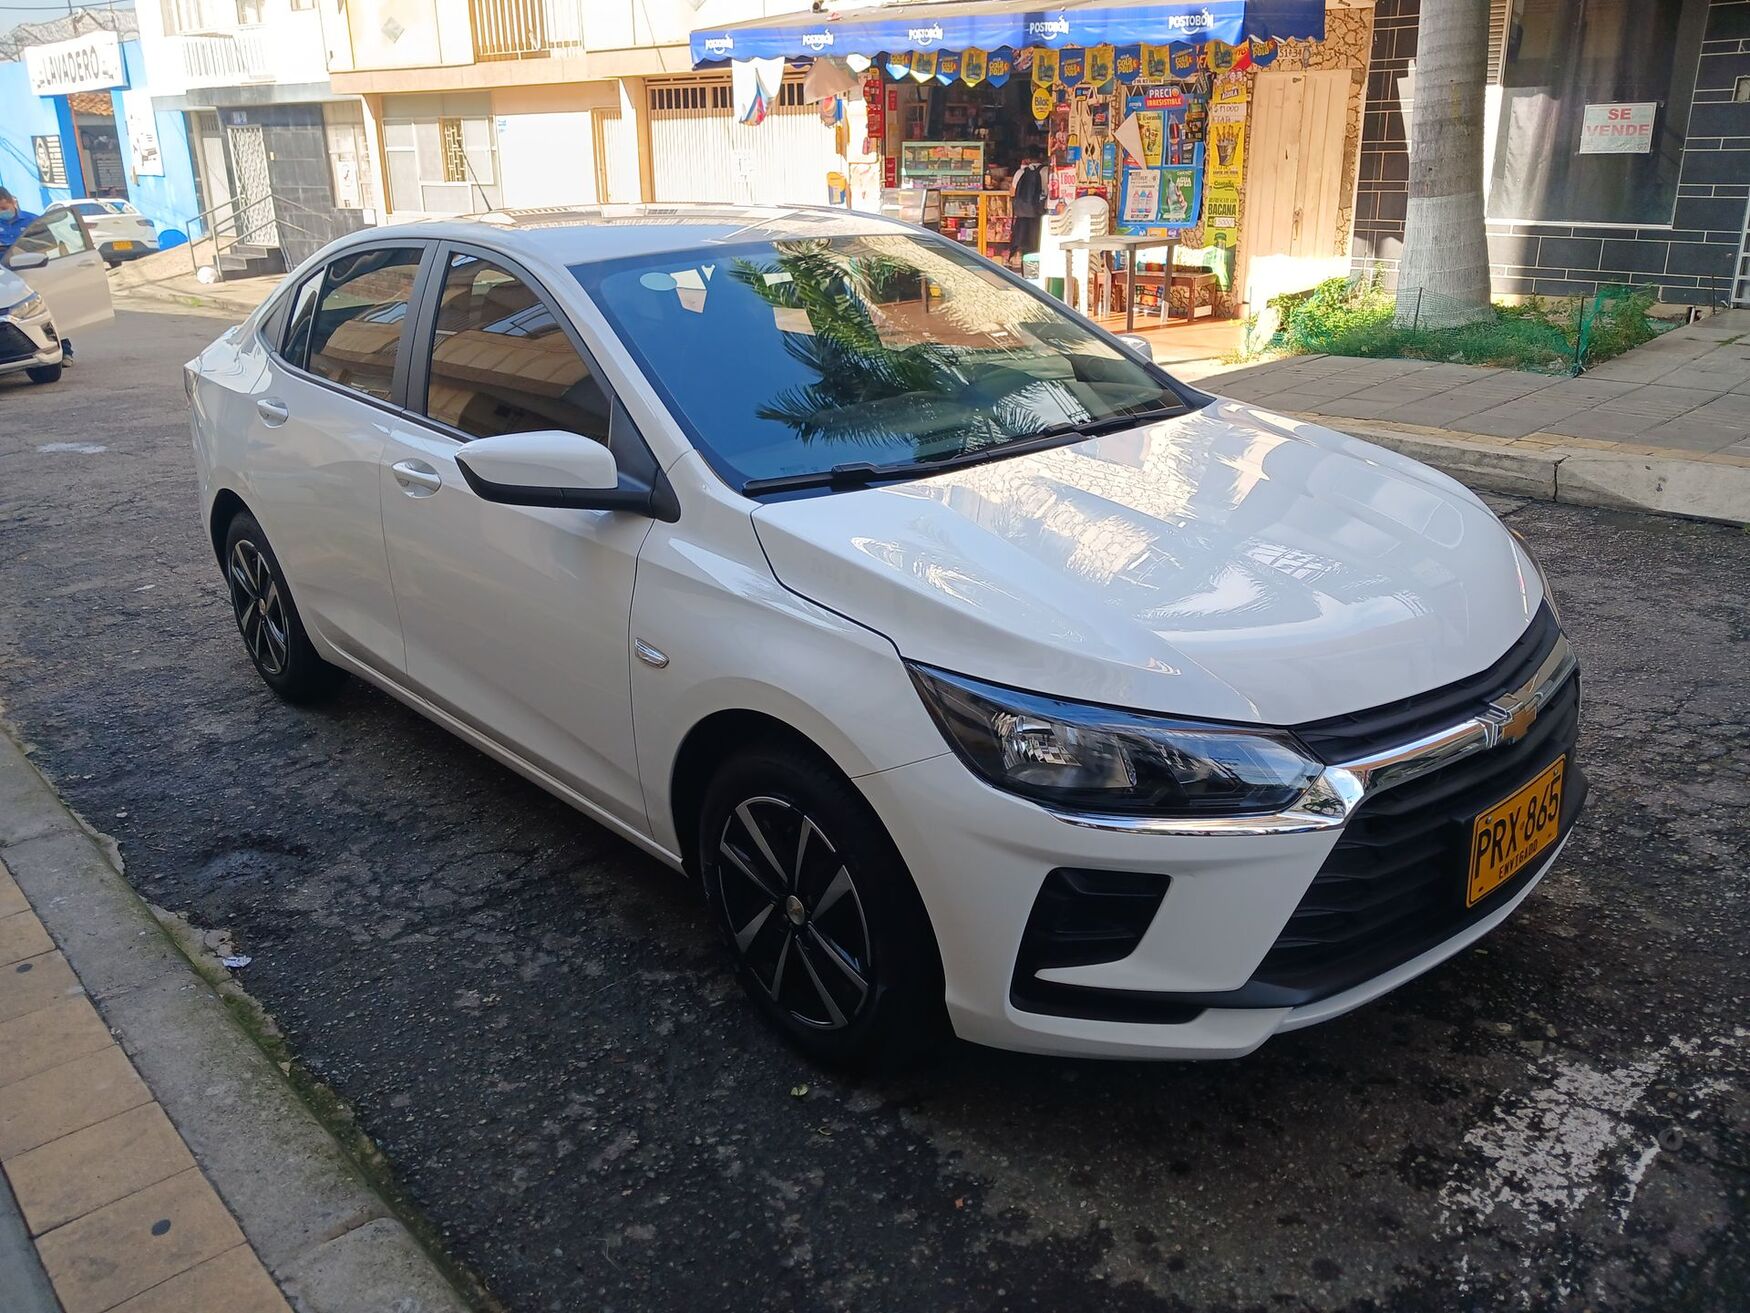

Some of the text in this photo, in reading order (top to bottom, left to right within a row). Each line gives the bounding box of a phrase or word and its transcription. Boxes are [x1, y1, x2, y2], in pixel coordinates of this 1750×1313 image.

[42, 45, 99, 85] LAVADERO
[1608, 108, 1632, 120] SE
[1587, 124, 1650, 136] VENDE
[1208, 203, 1236, 216] BACANA
[1474, 774, 1561, 879] PRX 865
[1499, 839, 1538, 878] ENVIGADO
